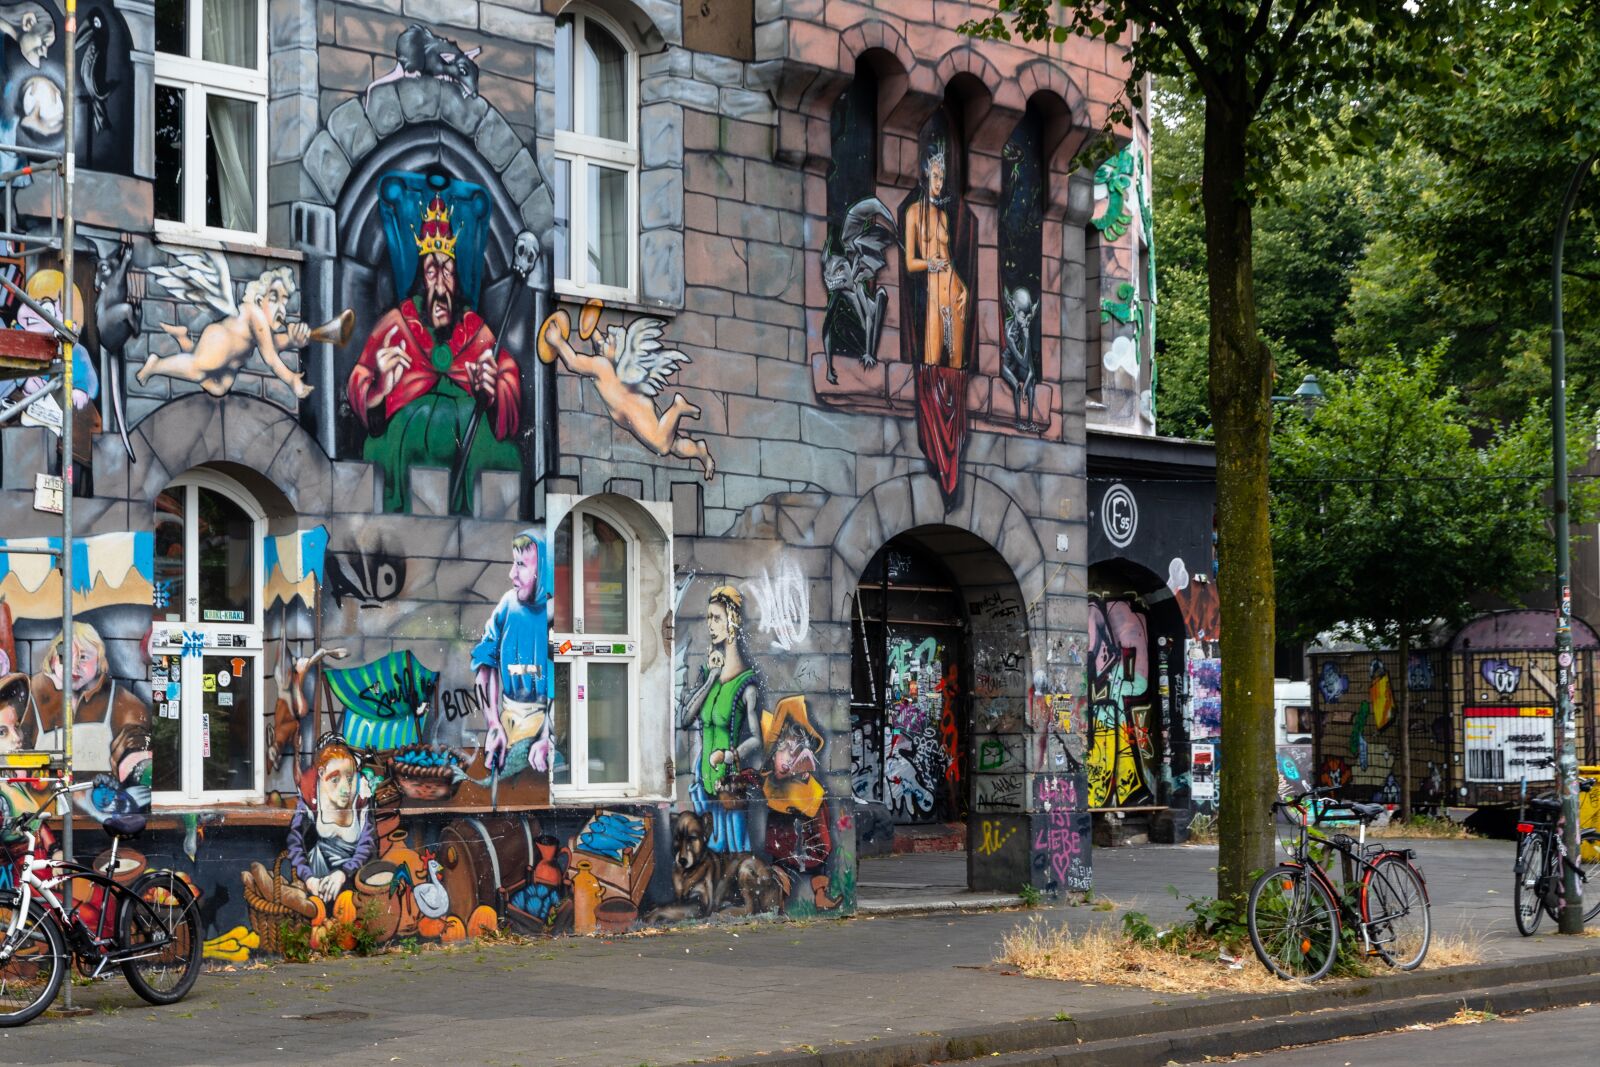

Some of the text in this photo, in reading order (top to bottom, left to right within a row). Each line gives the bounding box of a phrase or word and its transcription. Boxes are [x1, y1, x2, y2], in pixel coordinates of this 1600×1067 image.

[442, 684, 491, 721] BONN
[1050, 807, 1072, 827] IST
[1034, 829, 1081, 855] LIEBE
